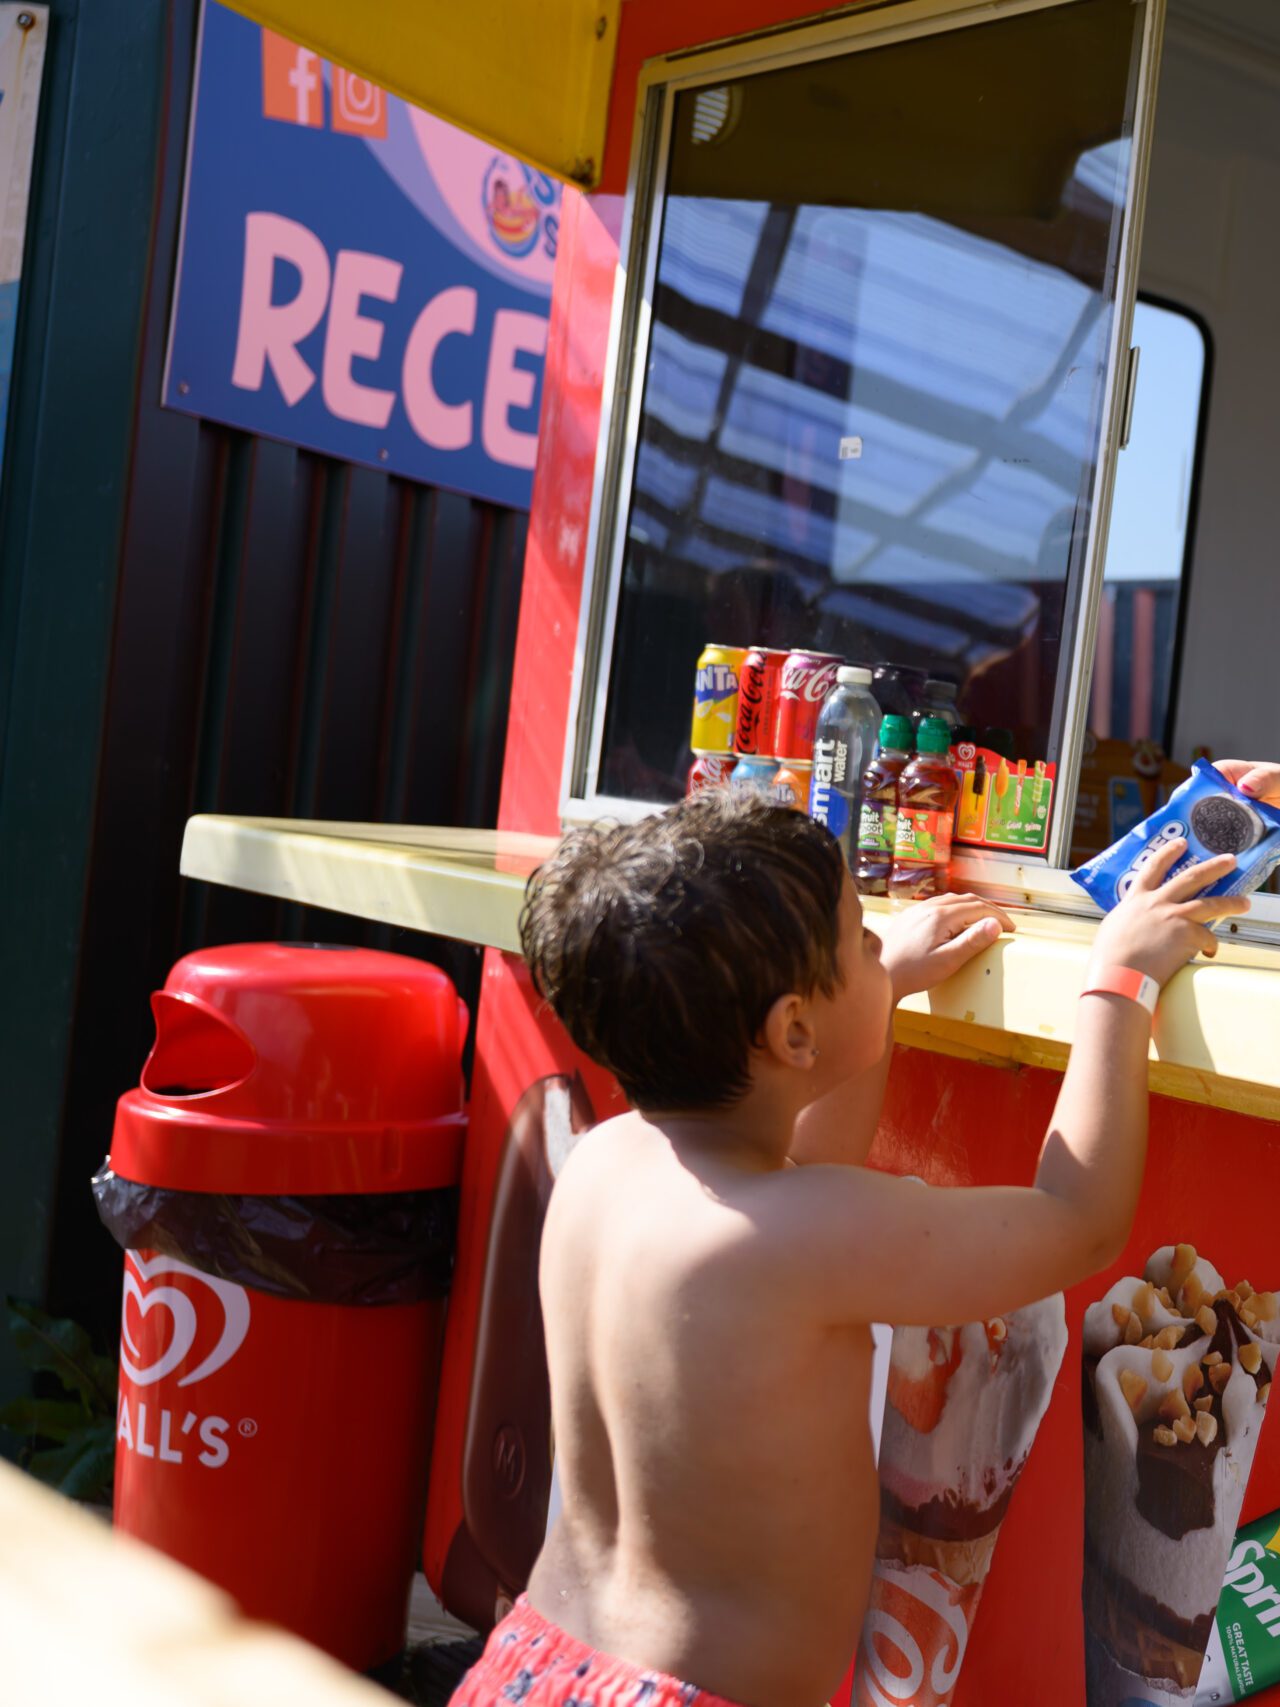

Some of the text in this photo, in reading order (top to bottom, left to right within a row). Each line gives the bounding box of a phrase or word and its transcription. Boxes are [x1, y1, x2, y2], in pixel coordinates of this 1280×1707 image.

[812, 738, 846, 827] smart
[833, 740, 849, 783] water
[117, 1390, 231, 1469] ALL'S
[1232, 1622, 1255, 1687] GREAT TASTE
